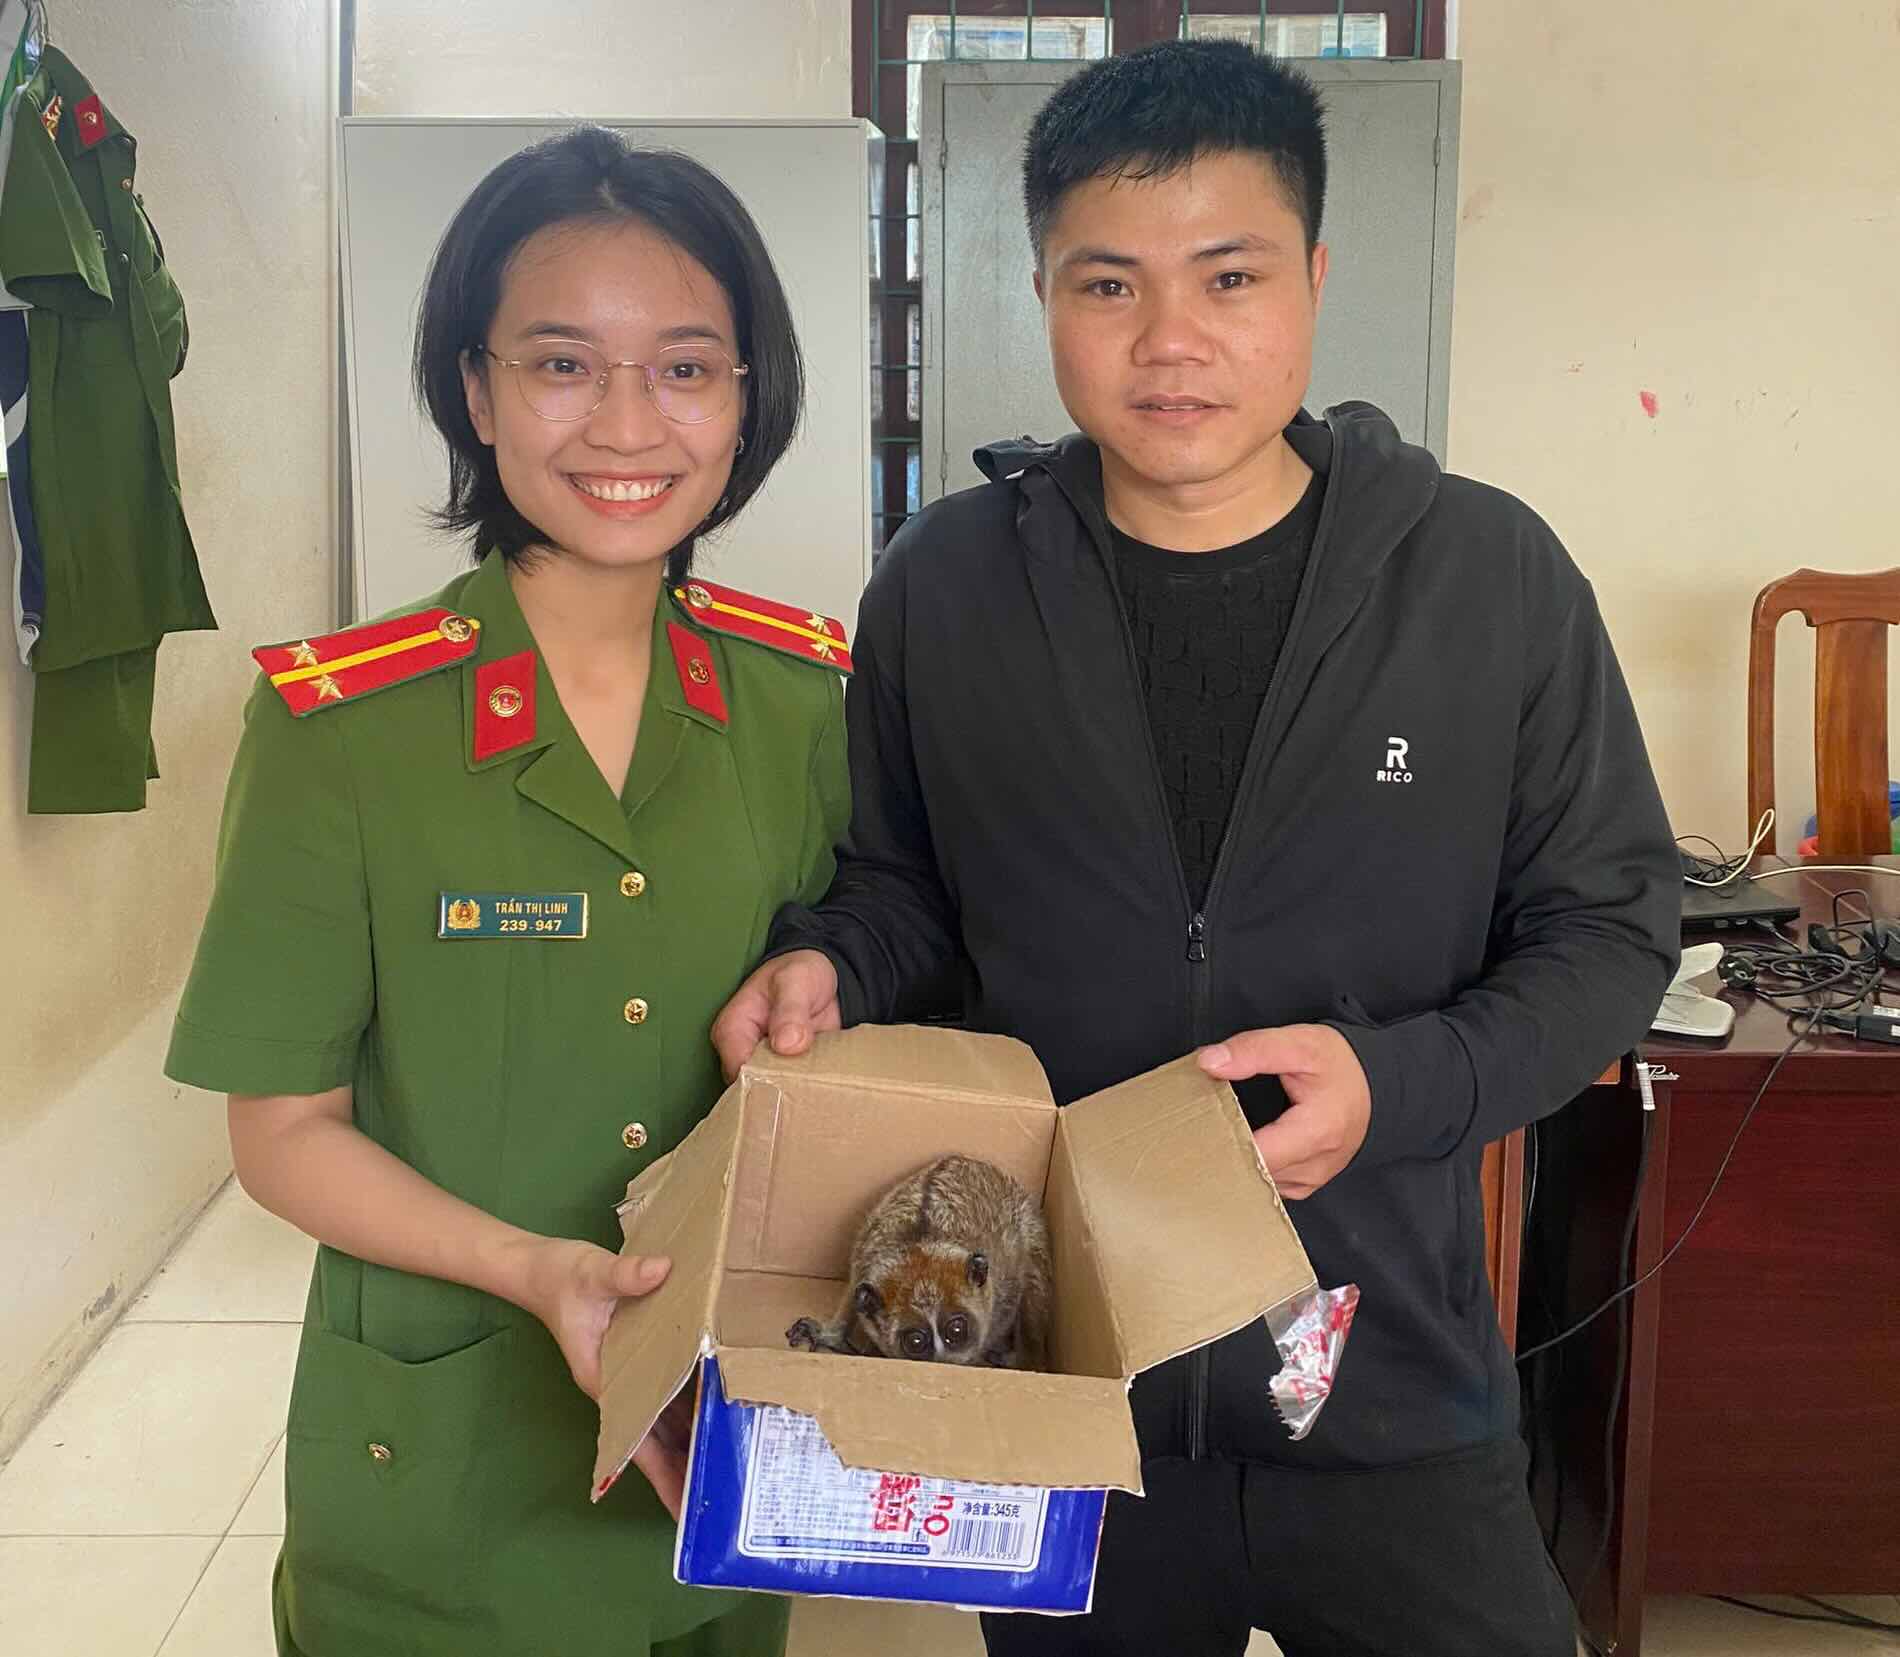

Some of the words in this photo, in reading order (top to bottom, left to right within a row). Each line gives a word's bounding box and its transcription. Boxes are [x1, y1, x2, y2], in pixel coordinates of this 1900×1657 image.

[1386, 736, 1408, 769] R
[1376, 770, 1412, 783] RICO
[526, 902, 542, 917] THỊ
[545, 902, 568, 914] LINH
